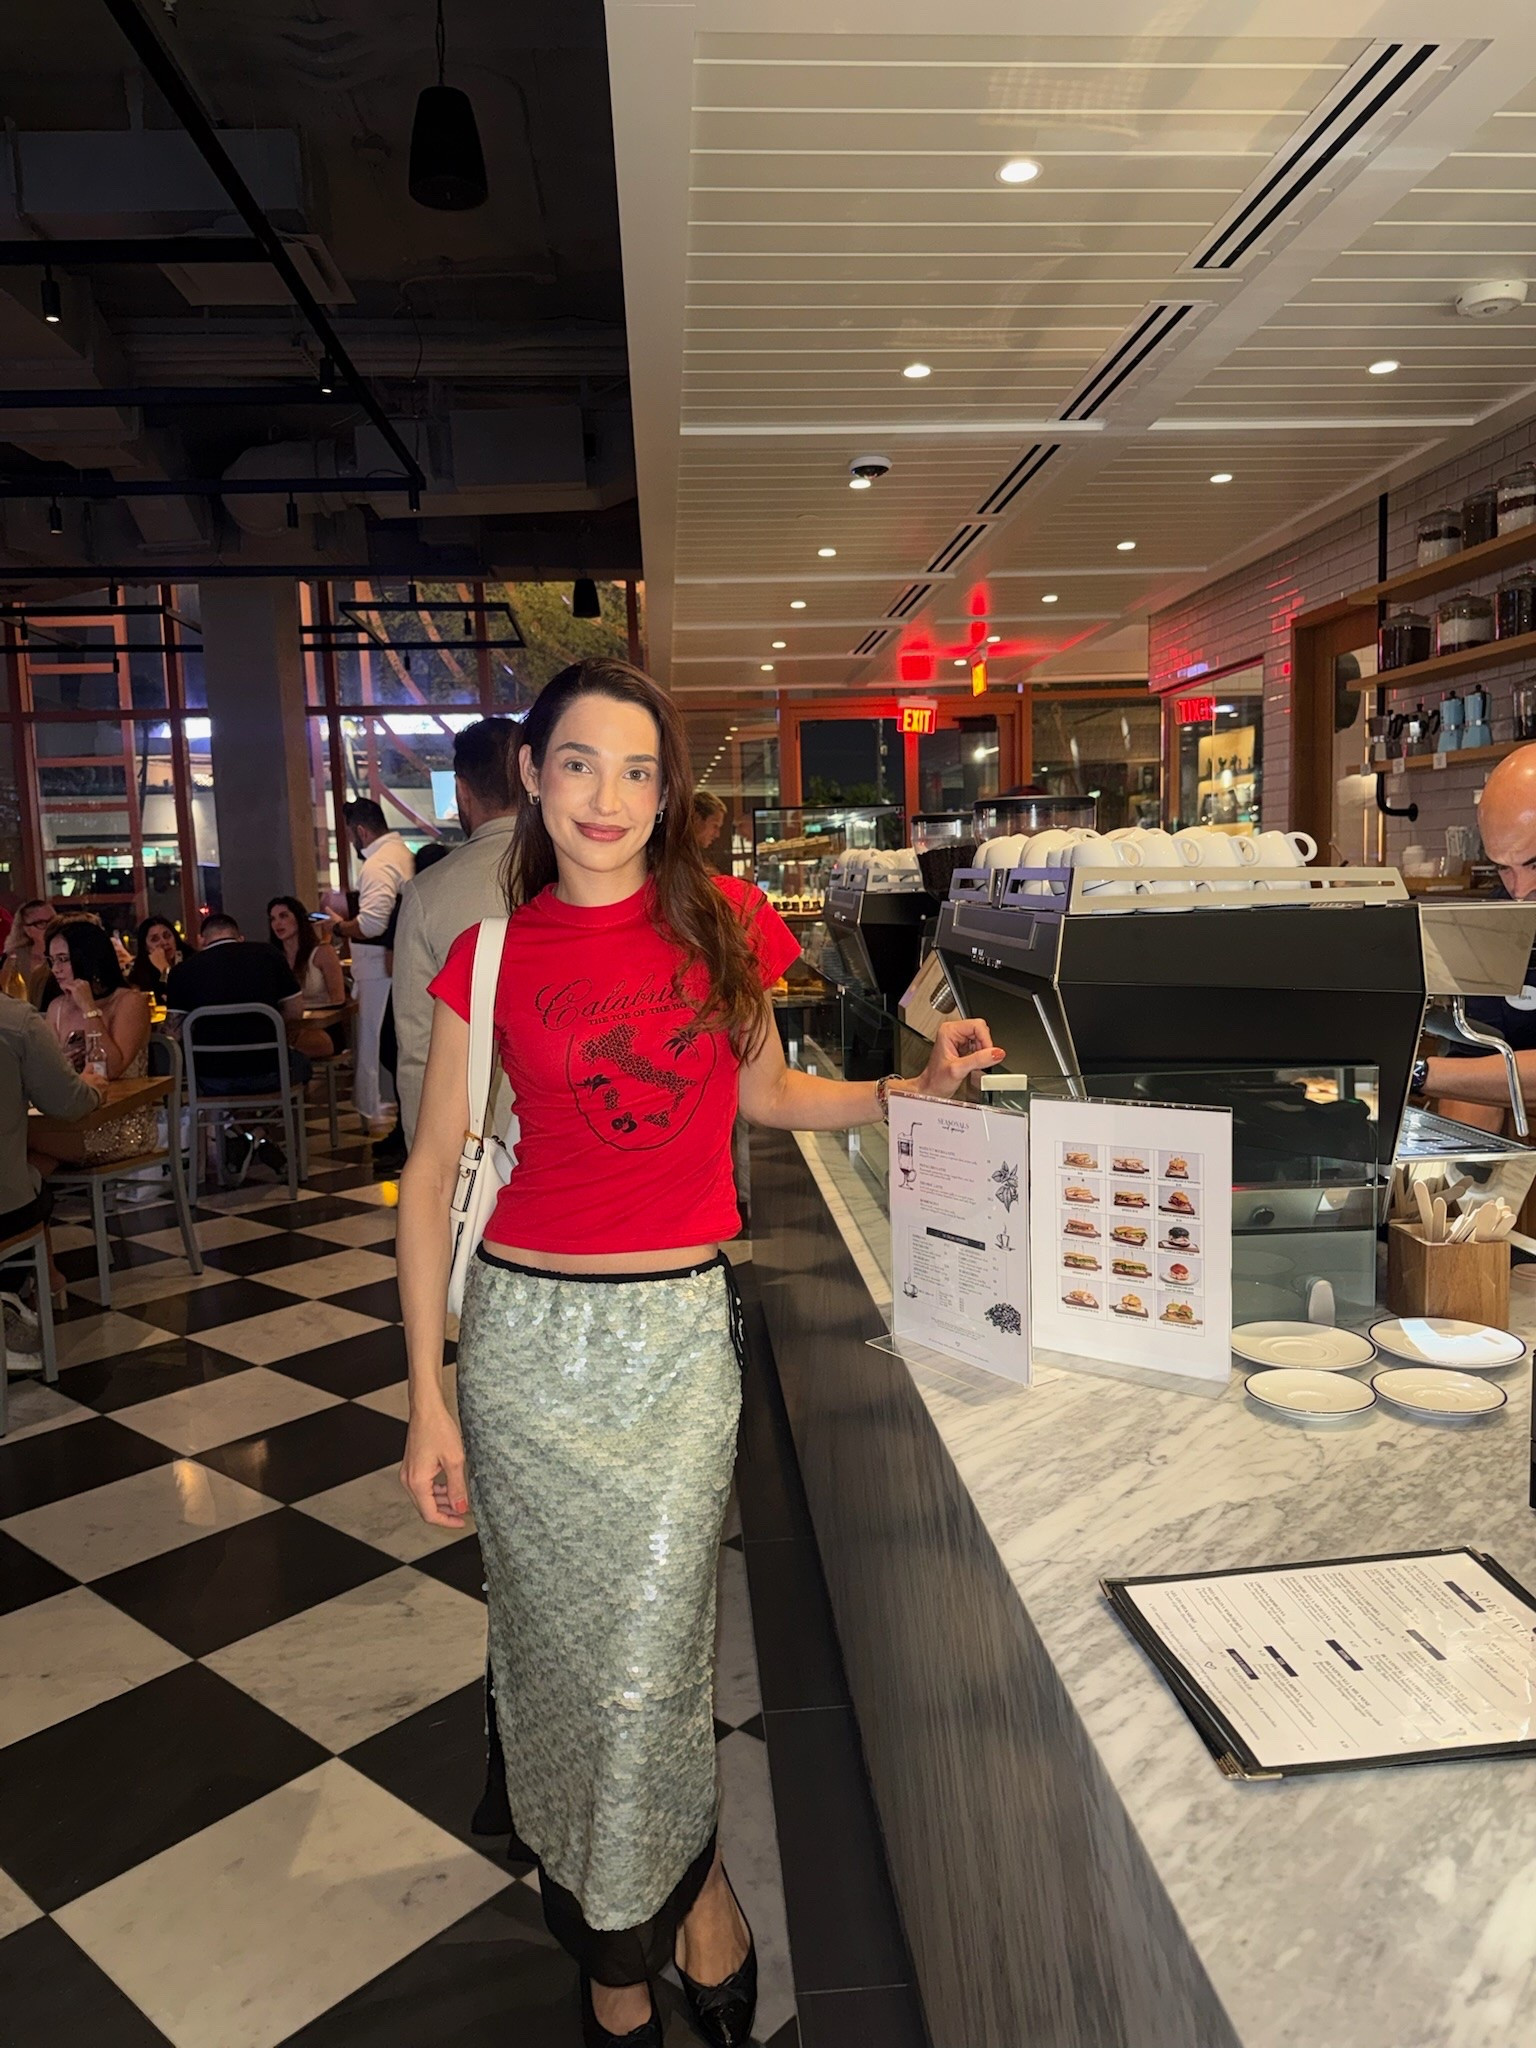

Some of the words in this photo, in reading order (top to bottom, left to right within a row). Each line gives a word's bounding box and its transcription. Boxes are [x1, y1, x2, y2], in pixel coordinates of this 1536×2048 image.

[903, 708, 931, 733] EXIT
[589, 1016, 609, 1026] THE
[612, 1012, 631, 1021] TOE
[633, 1009, 647, 1018] OF
[649, 1004, 671, 1015] THE
[1470, 1590, 1535, 1642] SPECIALS
